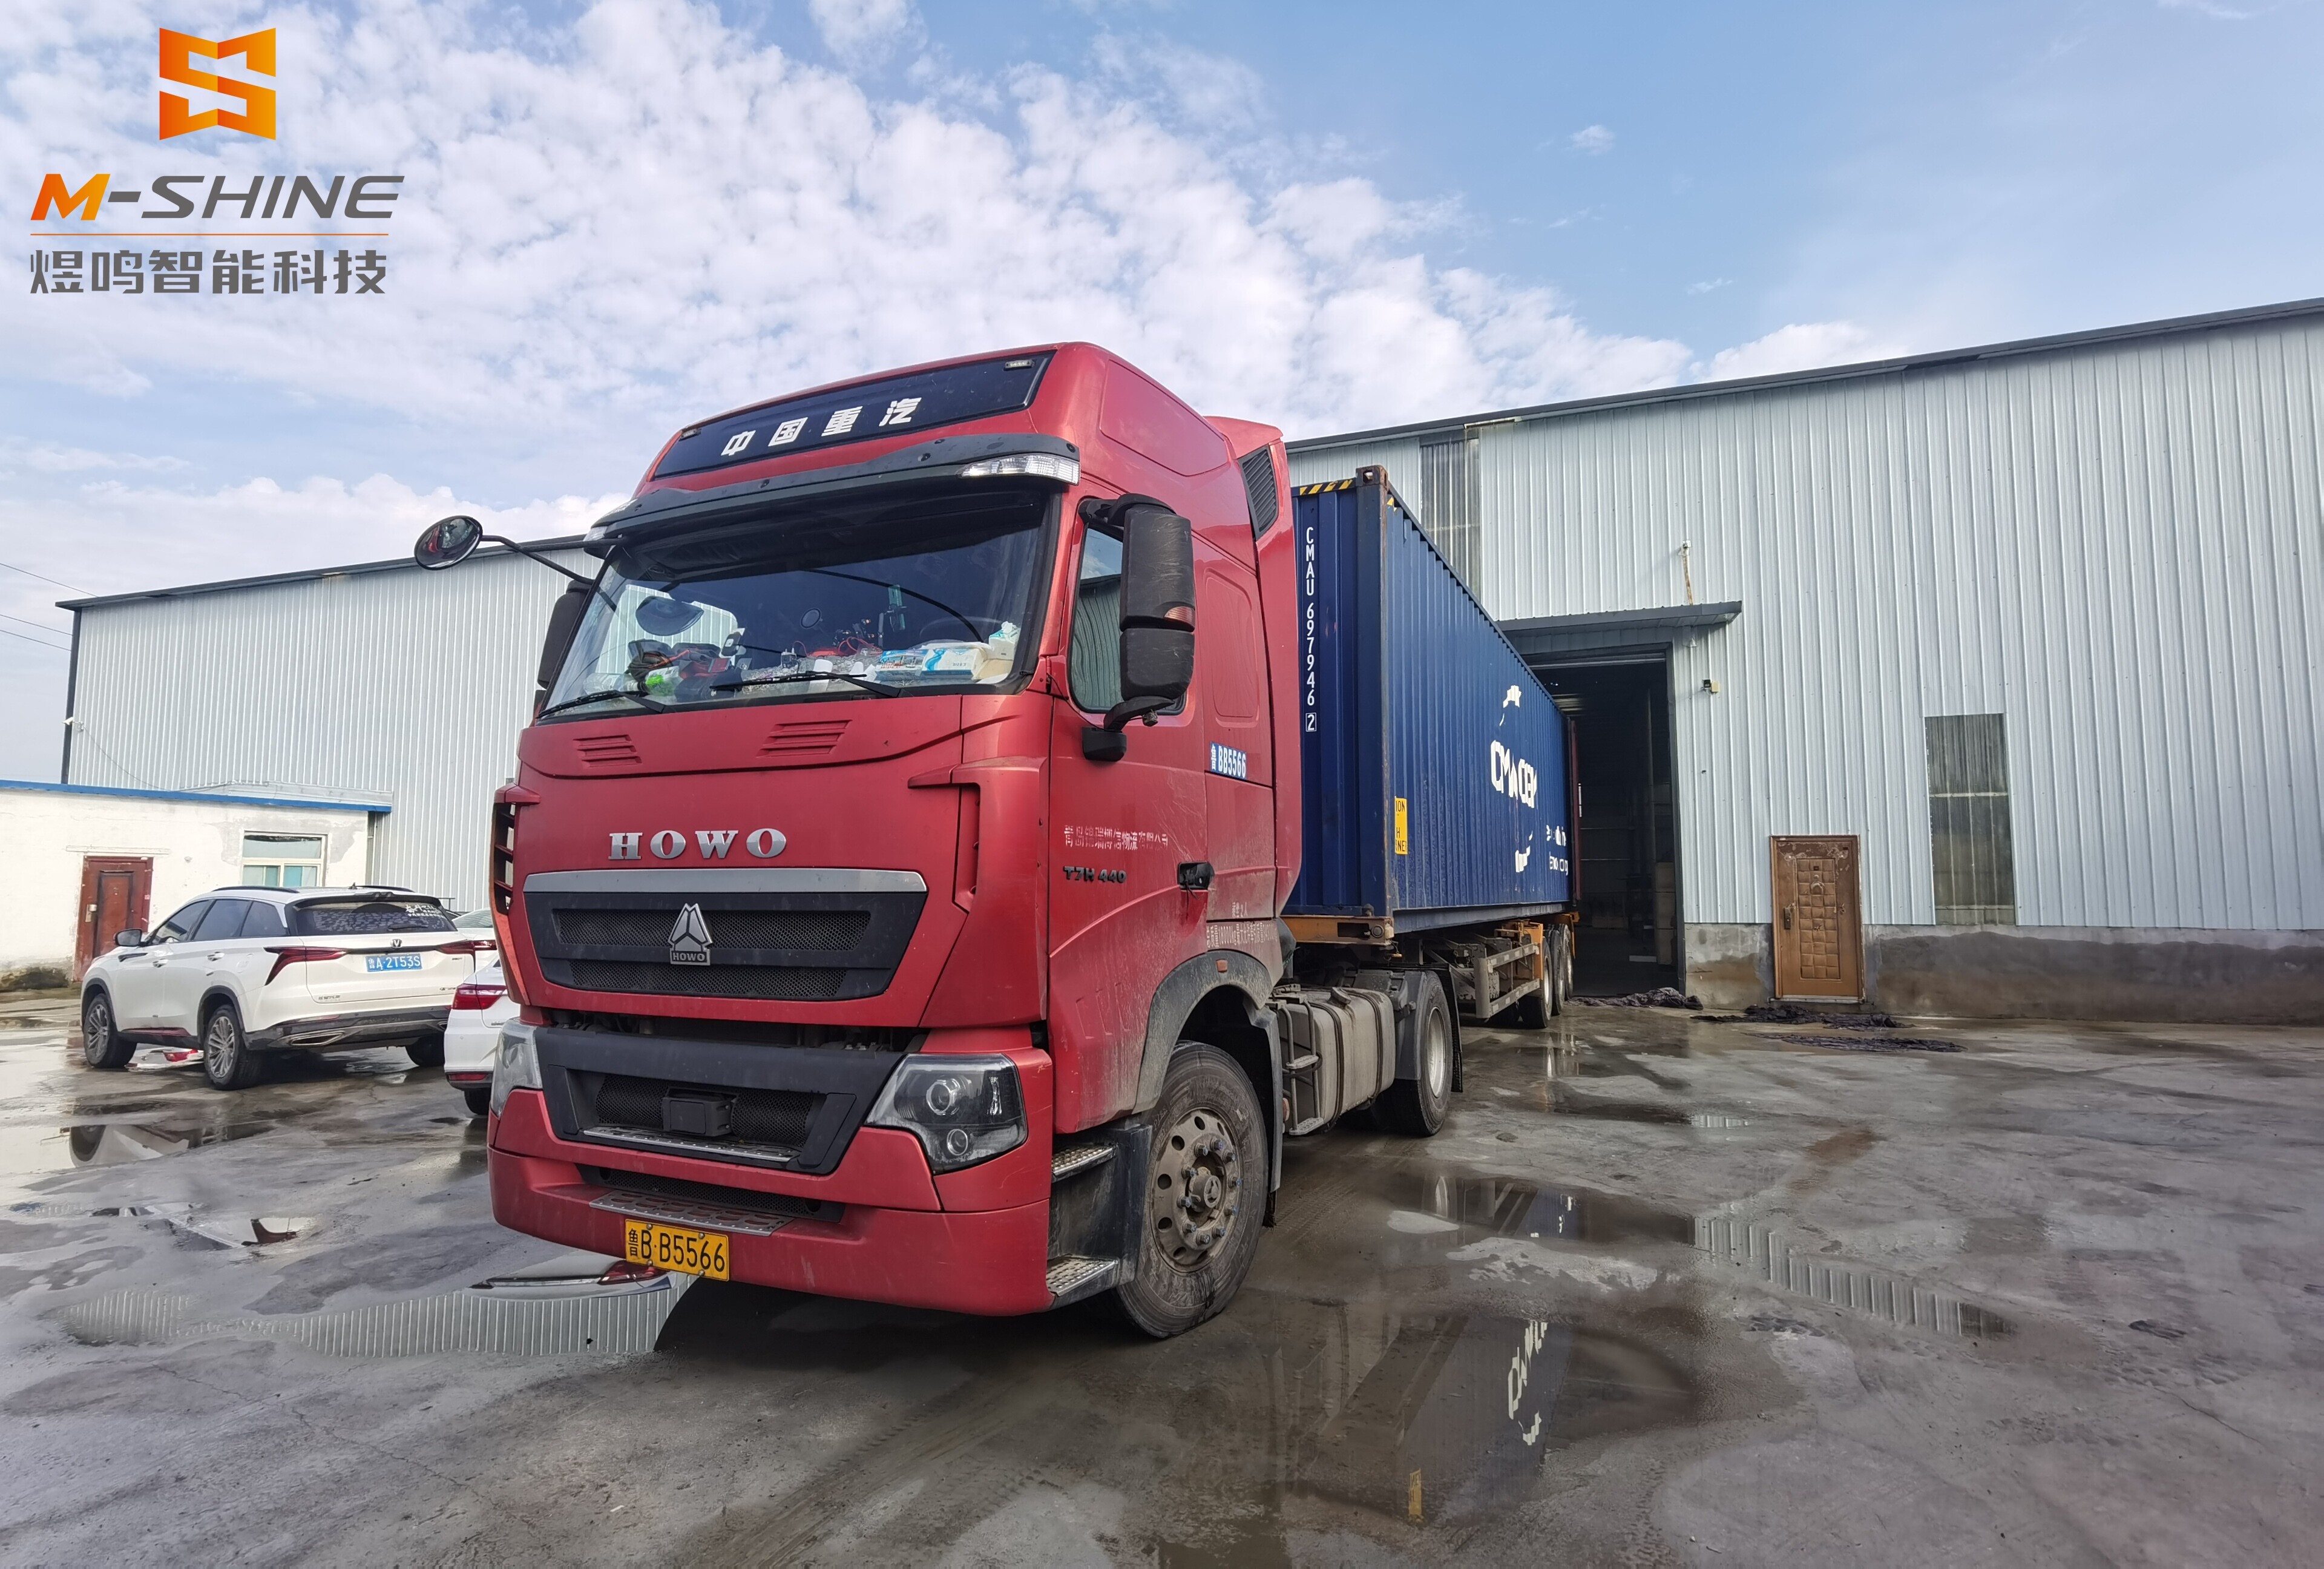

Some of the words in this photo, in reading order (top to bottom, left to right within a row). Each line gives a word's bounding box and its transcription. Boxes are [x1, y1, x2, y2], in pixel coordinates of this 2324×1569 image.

[721, 397, 922, 455] 中国重汽
[1306, 527, 1315, 596] CMAU
[1306, 602, 1315, 706] 697946
[1307, 714, 1315, 731] 2
[608, 828, 786, 860] HOWO
[1063, 866, 1095, 881] T7H
[1099, 869, 1127, 883] 440
[673, 952, 705, 961] HOWO
